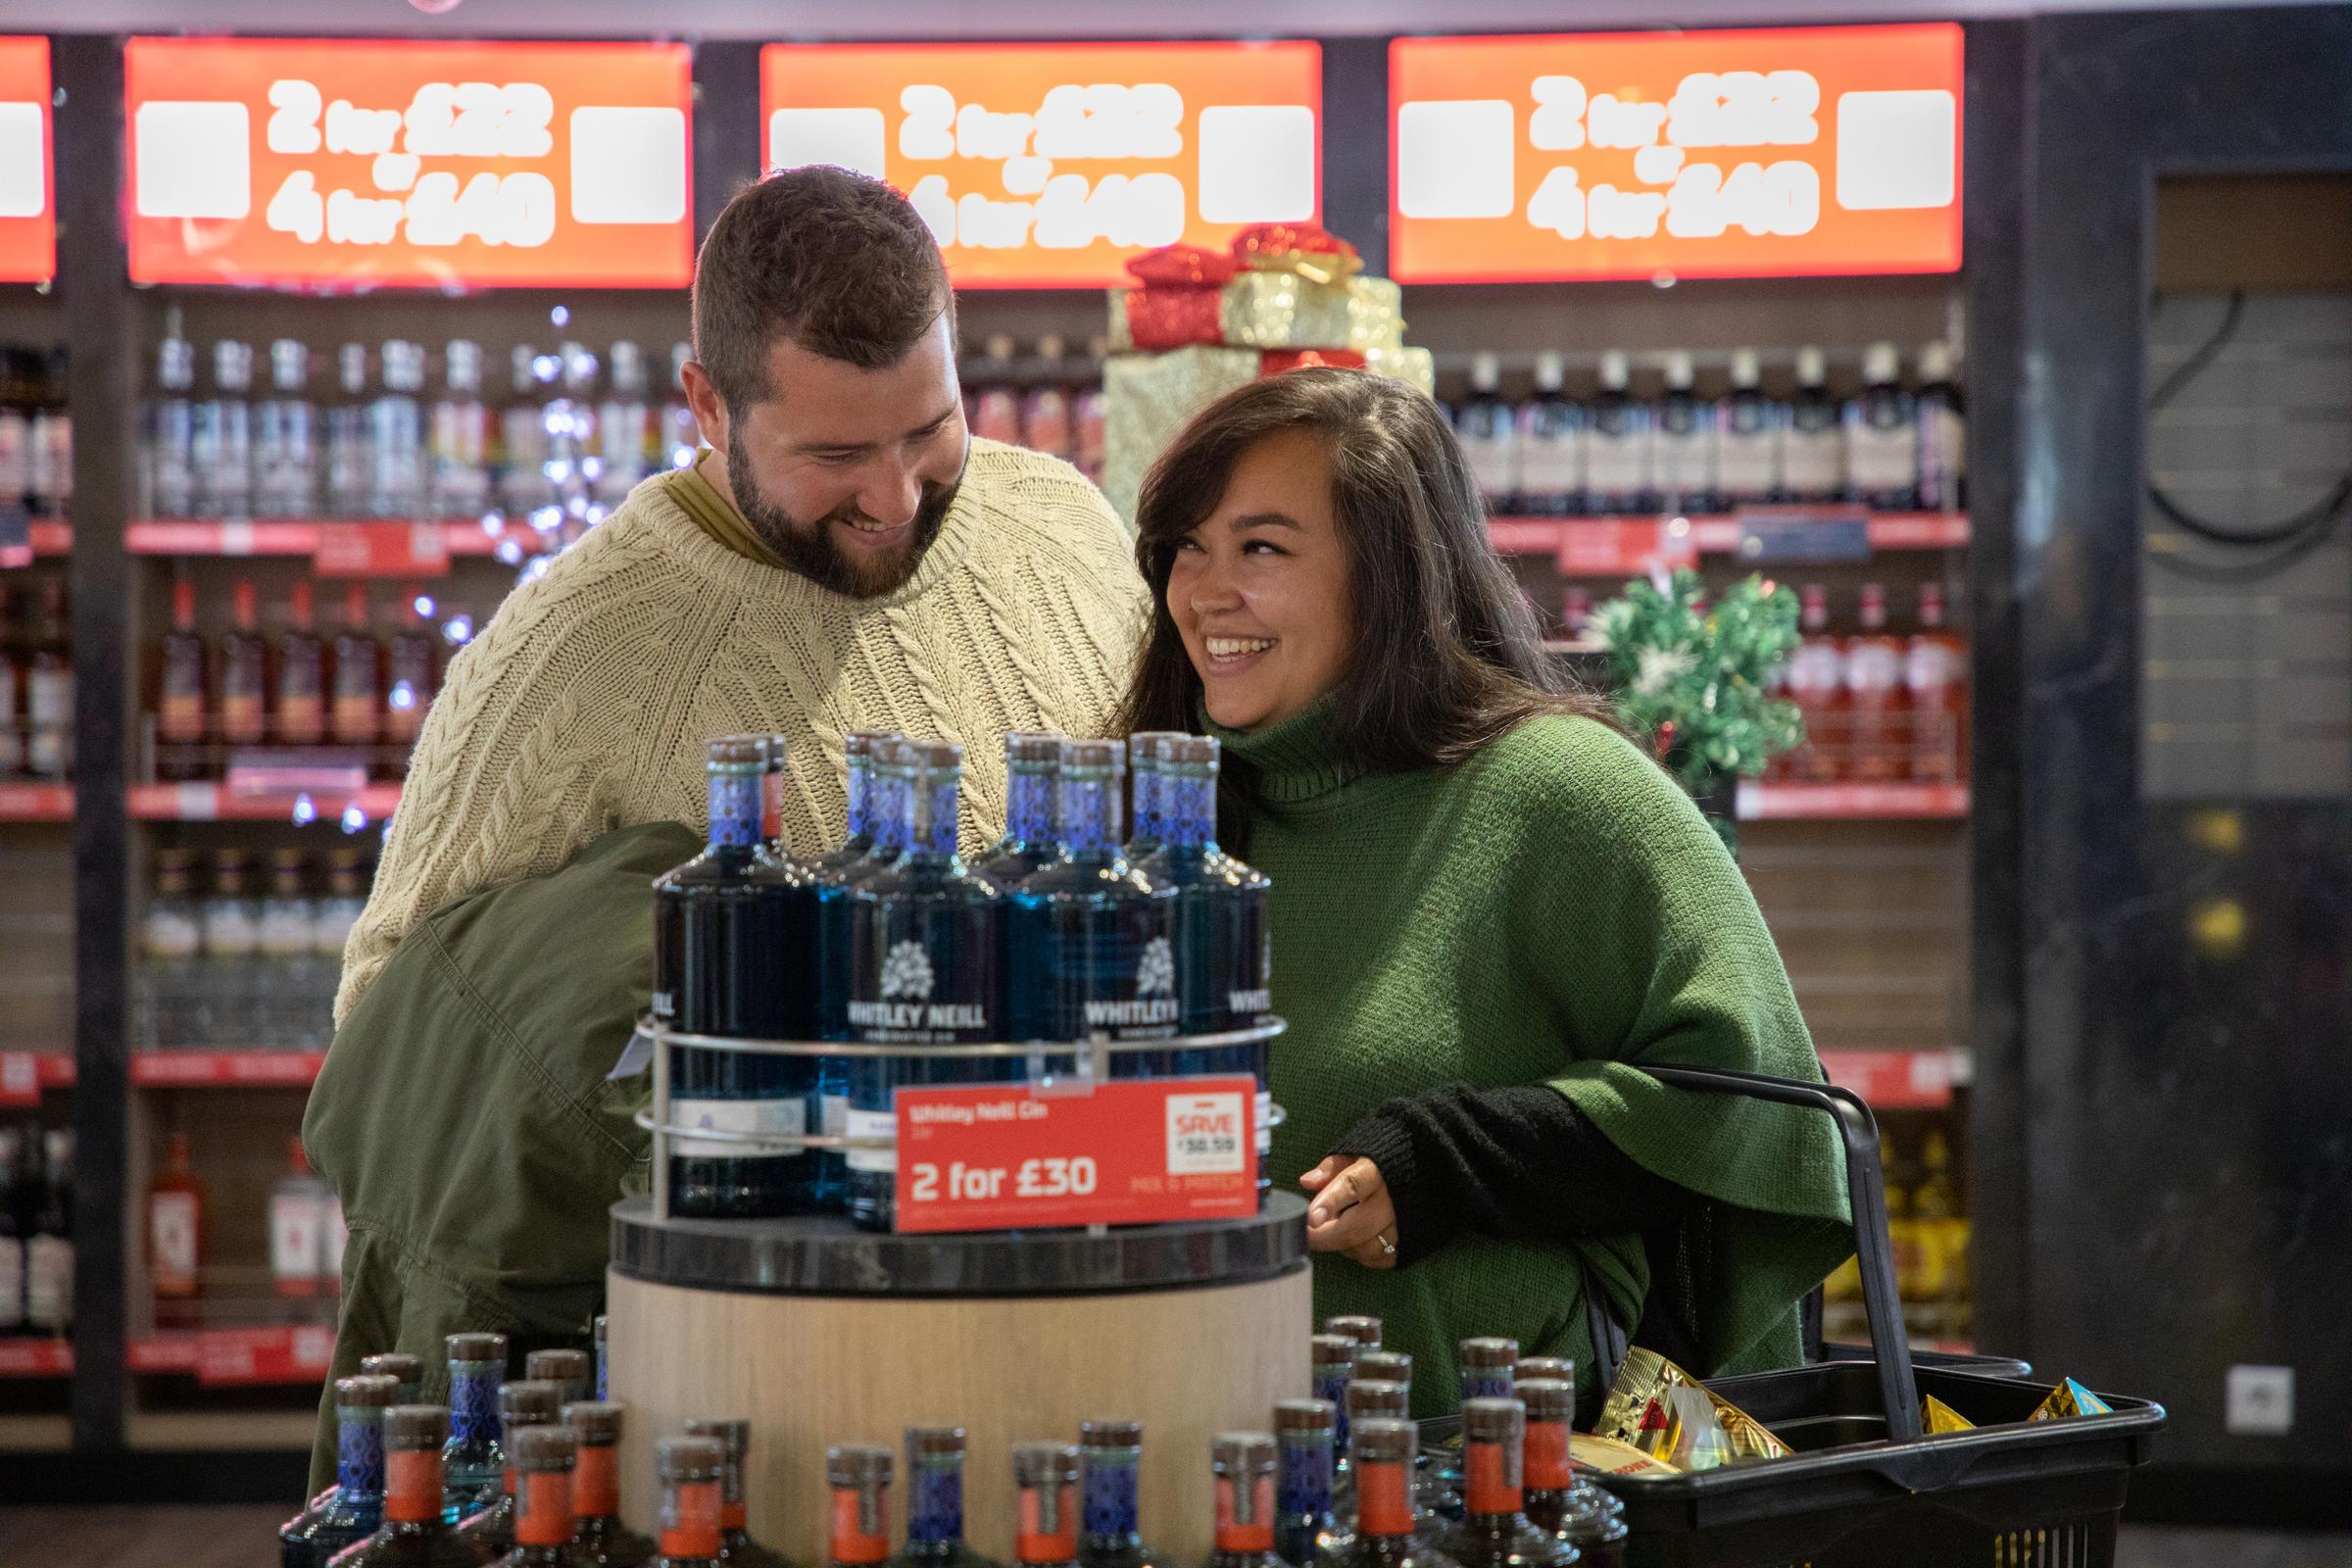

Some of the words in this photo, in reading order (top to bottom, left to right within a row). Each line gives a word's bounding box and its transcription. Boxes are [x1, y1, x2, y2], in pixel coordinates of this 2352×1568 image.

[1176, 1112, 1235, 1136] SAVE
[911, 1162, 939, 1201] 2
[949, 1160, 1007, 1200] for
[1015, 1155, 1097, 1199] £30
